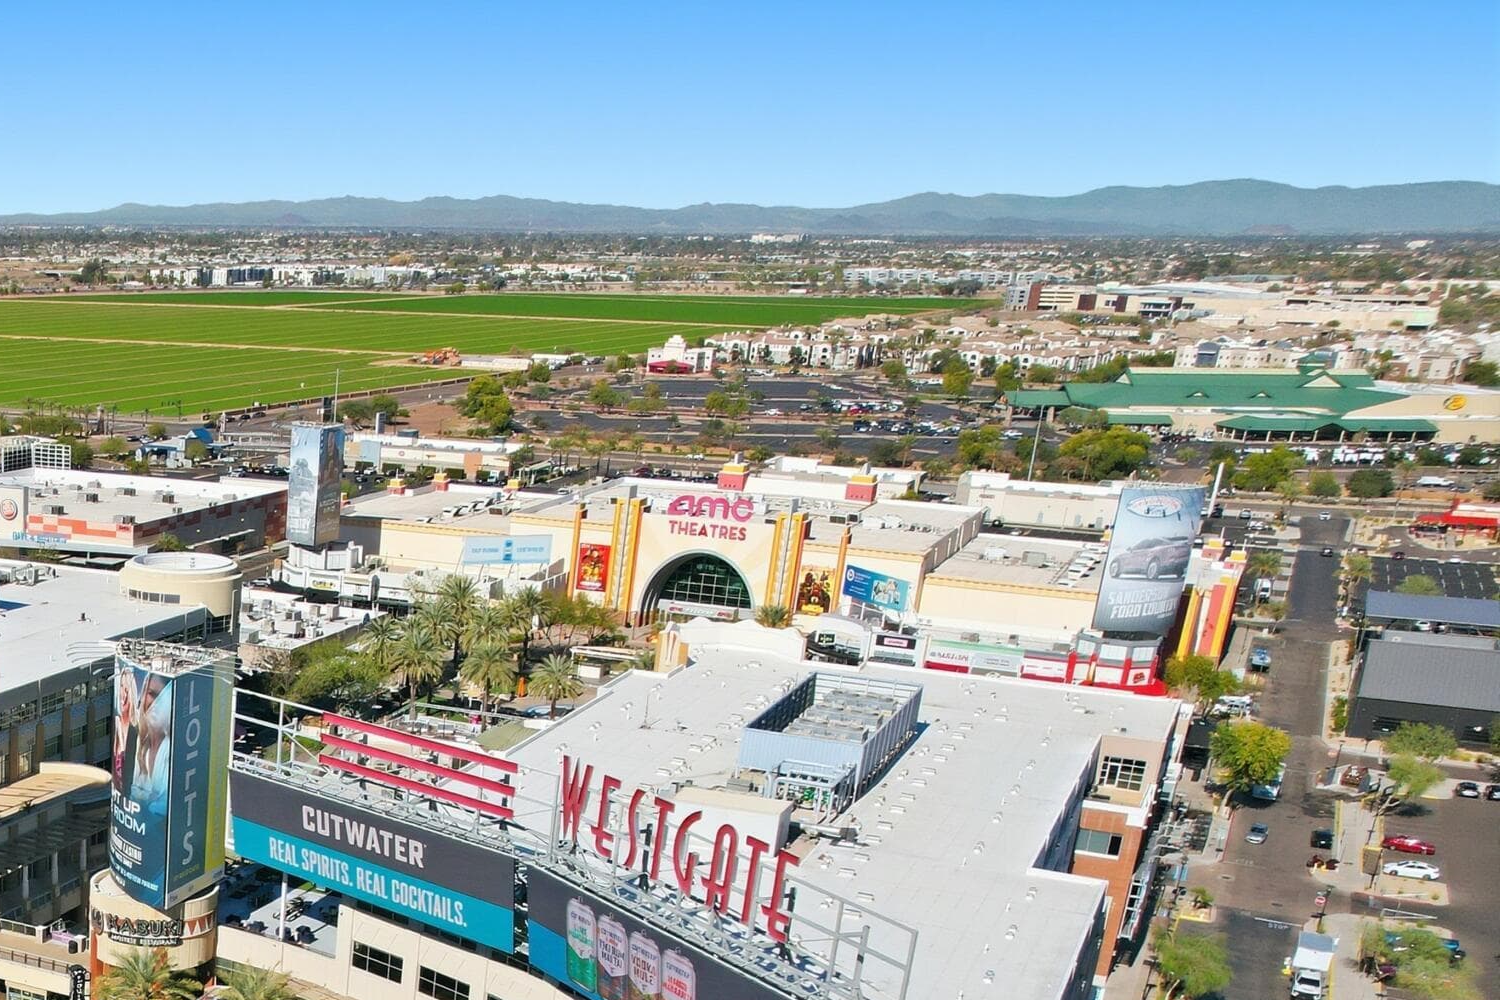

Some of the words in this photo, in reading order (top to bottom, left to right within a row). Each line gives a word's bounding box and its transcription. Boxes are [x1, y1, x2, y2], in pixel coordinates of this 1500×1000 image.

[669, 520, 747, 541] THEATRES
[1110, 603, 1140, 619] FORD
[123, 797, 140, 814] UP
[114, 804, 146, 835] ROOM
[302, 805, 425, 869] CUTWATER
[560, 755, 800, 943] WESTGATE
[269, 836, 299, 868] REAL
[301, 847, 353, 887] SPIRITS.
[357, 866, 388, 899] REAL
[391, 879, 468, 927] COCKTAILS.
[105, 912, 183, 938] KABUKI
[631, 954, 656, 977] VODKA
[633, 966, 654, 986] MULE
